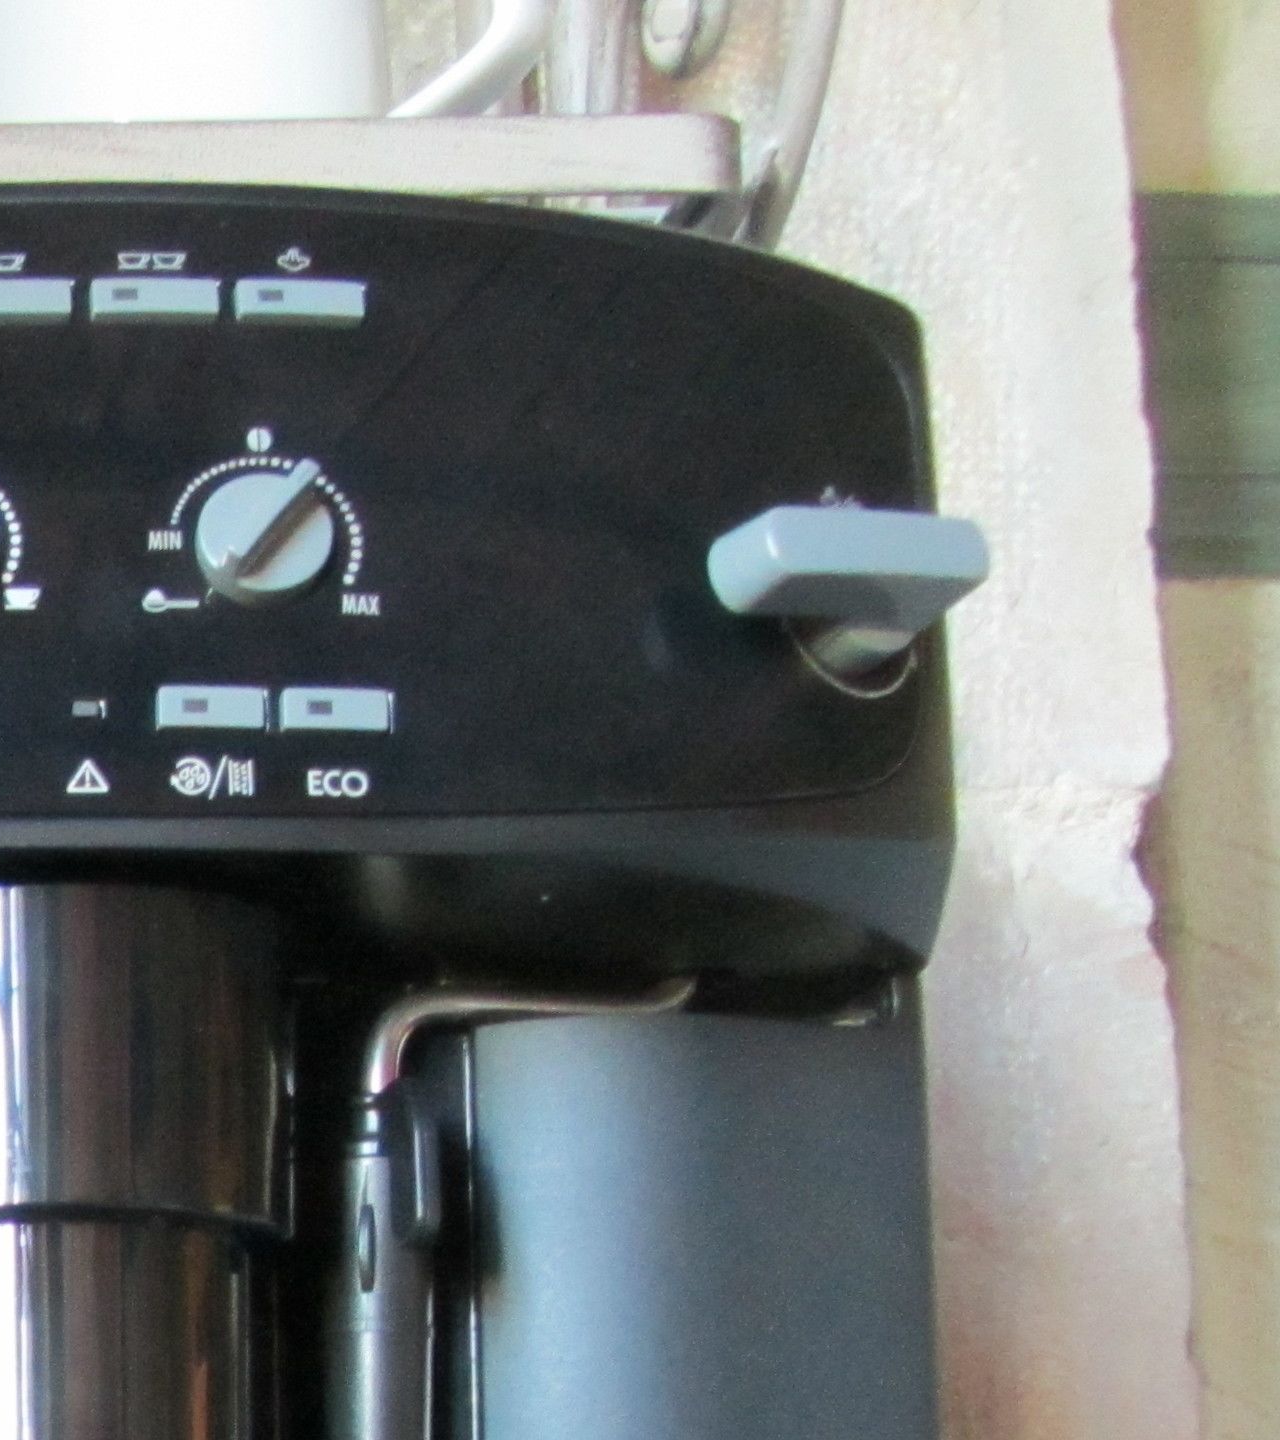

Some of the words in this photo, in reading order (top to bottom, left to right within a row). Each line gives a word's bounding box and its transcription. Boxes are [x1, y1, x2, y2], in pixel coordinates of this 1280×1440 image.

[148, 529, 183, 552] MIN
[341, 592, 381, 617] MAX
[306, 768, 369, 798] ECO
